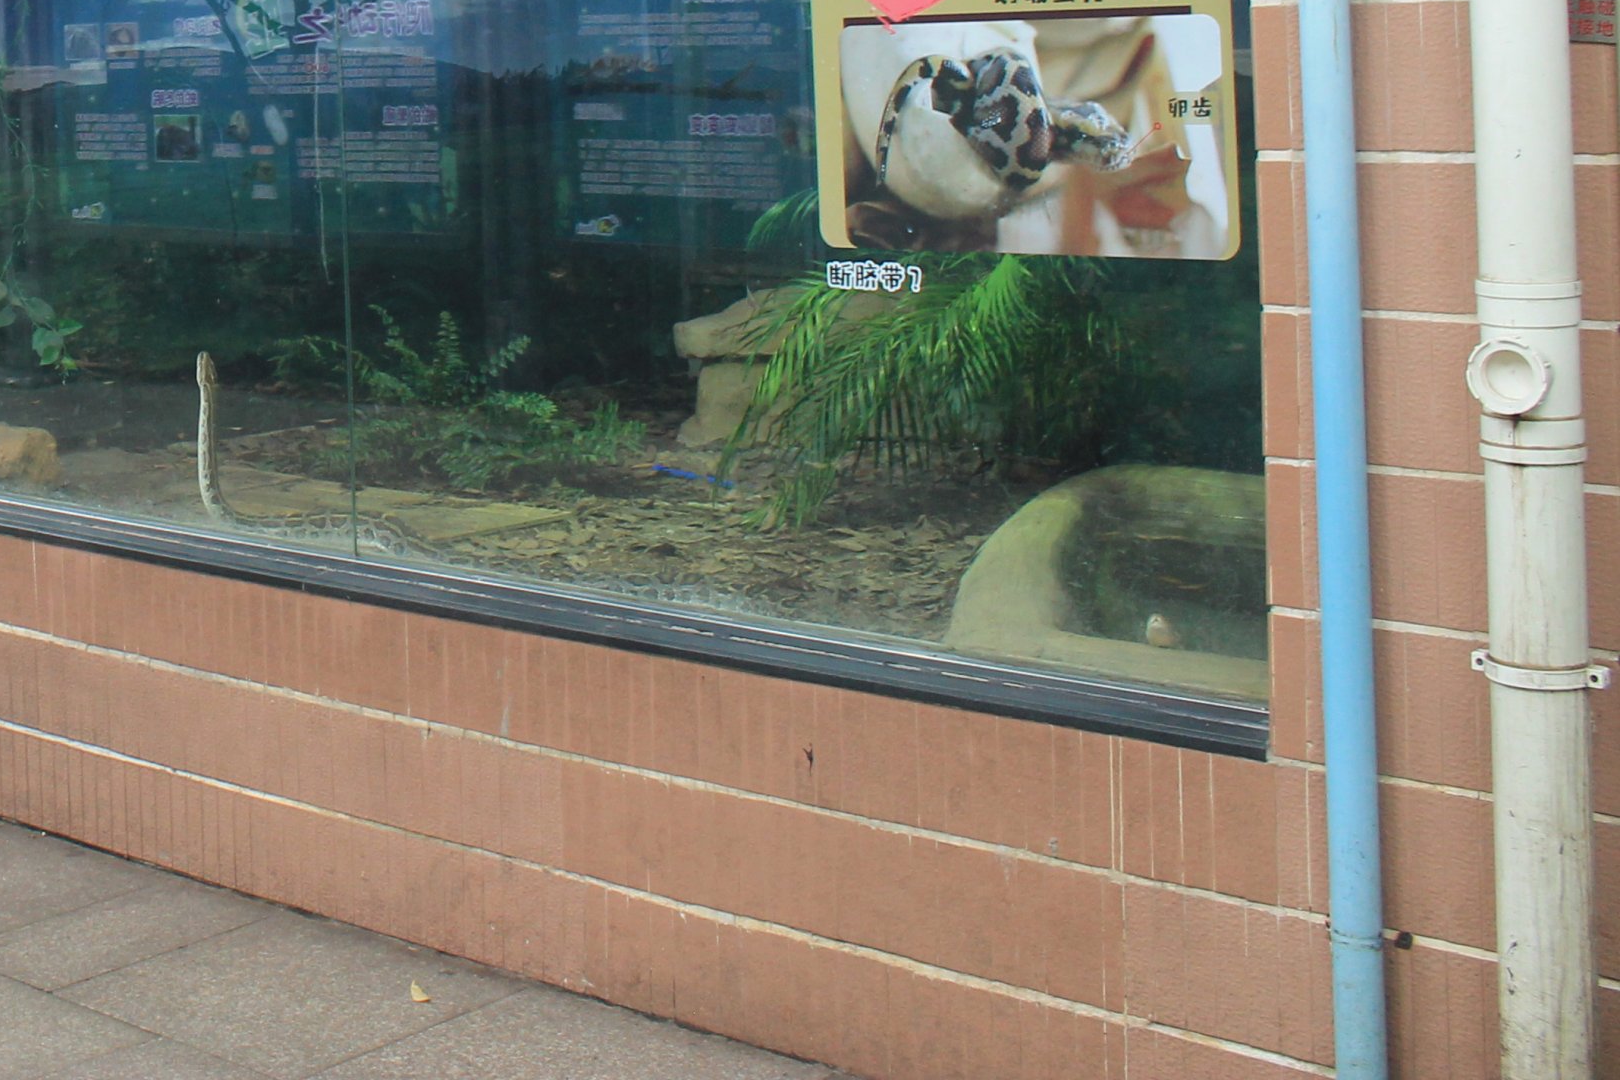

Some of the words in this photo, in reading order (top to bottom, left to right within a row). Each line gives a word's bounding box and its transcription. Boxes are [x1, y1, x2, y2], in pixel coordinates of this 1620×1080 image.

[1168, 94, 1213, 119] 卵齿
[826, 260, 923, 293] 断脐带？
